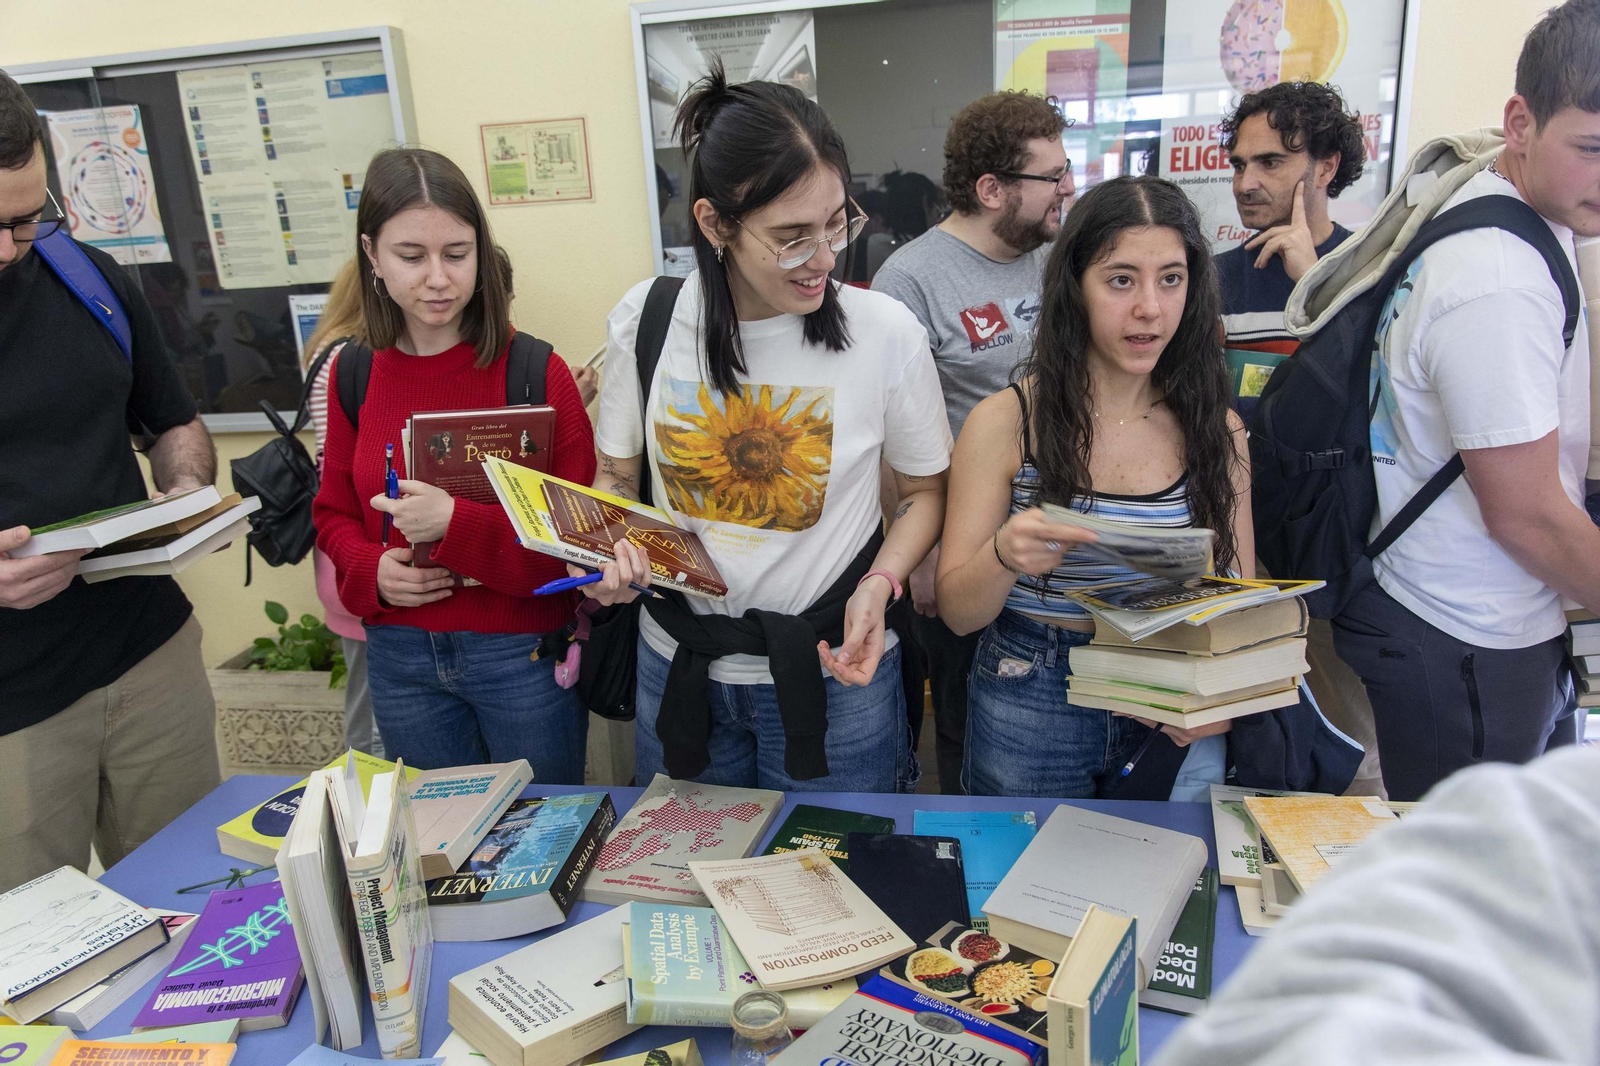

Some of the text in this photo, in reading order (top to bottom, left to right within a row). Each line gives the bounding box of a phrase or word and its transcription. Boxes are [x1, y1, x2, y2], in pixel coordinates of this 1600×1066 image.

[1172, 126, 1204, 143] TODO
[1170, 145, 1230, 172] ELIGE
[1178, 176, 1209, 184] obesidad
[1218, 176, 1233, 184] resp
[1217, 226, 1252, 242] Elige
[466, 433, 512, 441] Entrenamiento
[464, 446, 512, 462] Perro
[1372, 456, 1396, 466] NITED
[564, 534, 580, 544] Austin
[564, 548, 580, 558] Fungal,
[580, 553, 599, 564] Bacterial,
[700, 582, 722, 593] Cambridge
[789, 836, 838, 850] IN SPAIN
[802, 834, 840, 844] 1177-1740
[566, 838, 596, 892] INTERNET
[432, 867, 555, 898] INTERNET
[366, 878, 395, 964] Project Management
[650, 912, 666, 940] Data
[86, 914, 144, 946] of Fishes
[664, 912, 684, 961] Analysis
[796, 932, 836, 943] RUMINANTS
[354, 881, 389, 1012] STRATEGIC DESIGN AND IMPLEMENTATION
[680, 914, 704, 981] by Example
[704, 942, 714, 964] VOLUME
[762, 932, 894, 972] FEED COMPOSITION
[776, 944, 827, 956] COMPOSITION
[1164, 942, 1198, 958] Poli
[8, 918, 152, 995] The Chemical Biology
[650, 942, 670, 984] Spatial
[1157, 955, 1197, 974] Dec
[494, 965, 507, 976] Rojo
[162, 980, 224, 992] David Laidler
[478, 977, 500, 992] social
[718, 978, 726, 992] Point
[1152, 968, 1196, 990] Mod
[206, 1005, 216, 1014] la
[224, 998, 278, 1012] Introducción
[476, 986, 530, 1034] Historia económica
[500, 992, 536, 1024] pensamiento
[538, 1002, 558, 1020] Gonzalo
[547, 1000, 562, 1014] Pedro
[532, 1008, 550, 1024] Edición
[846, 1008, 1007, 1066] DICTIONARY
[76, 1047, 210, 1060] SEGUIMIENTO Y
